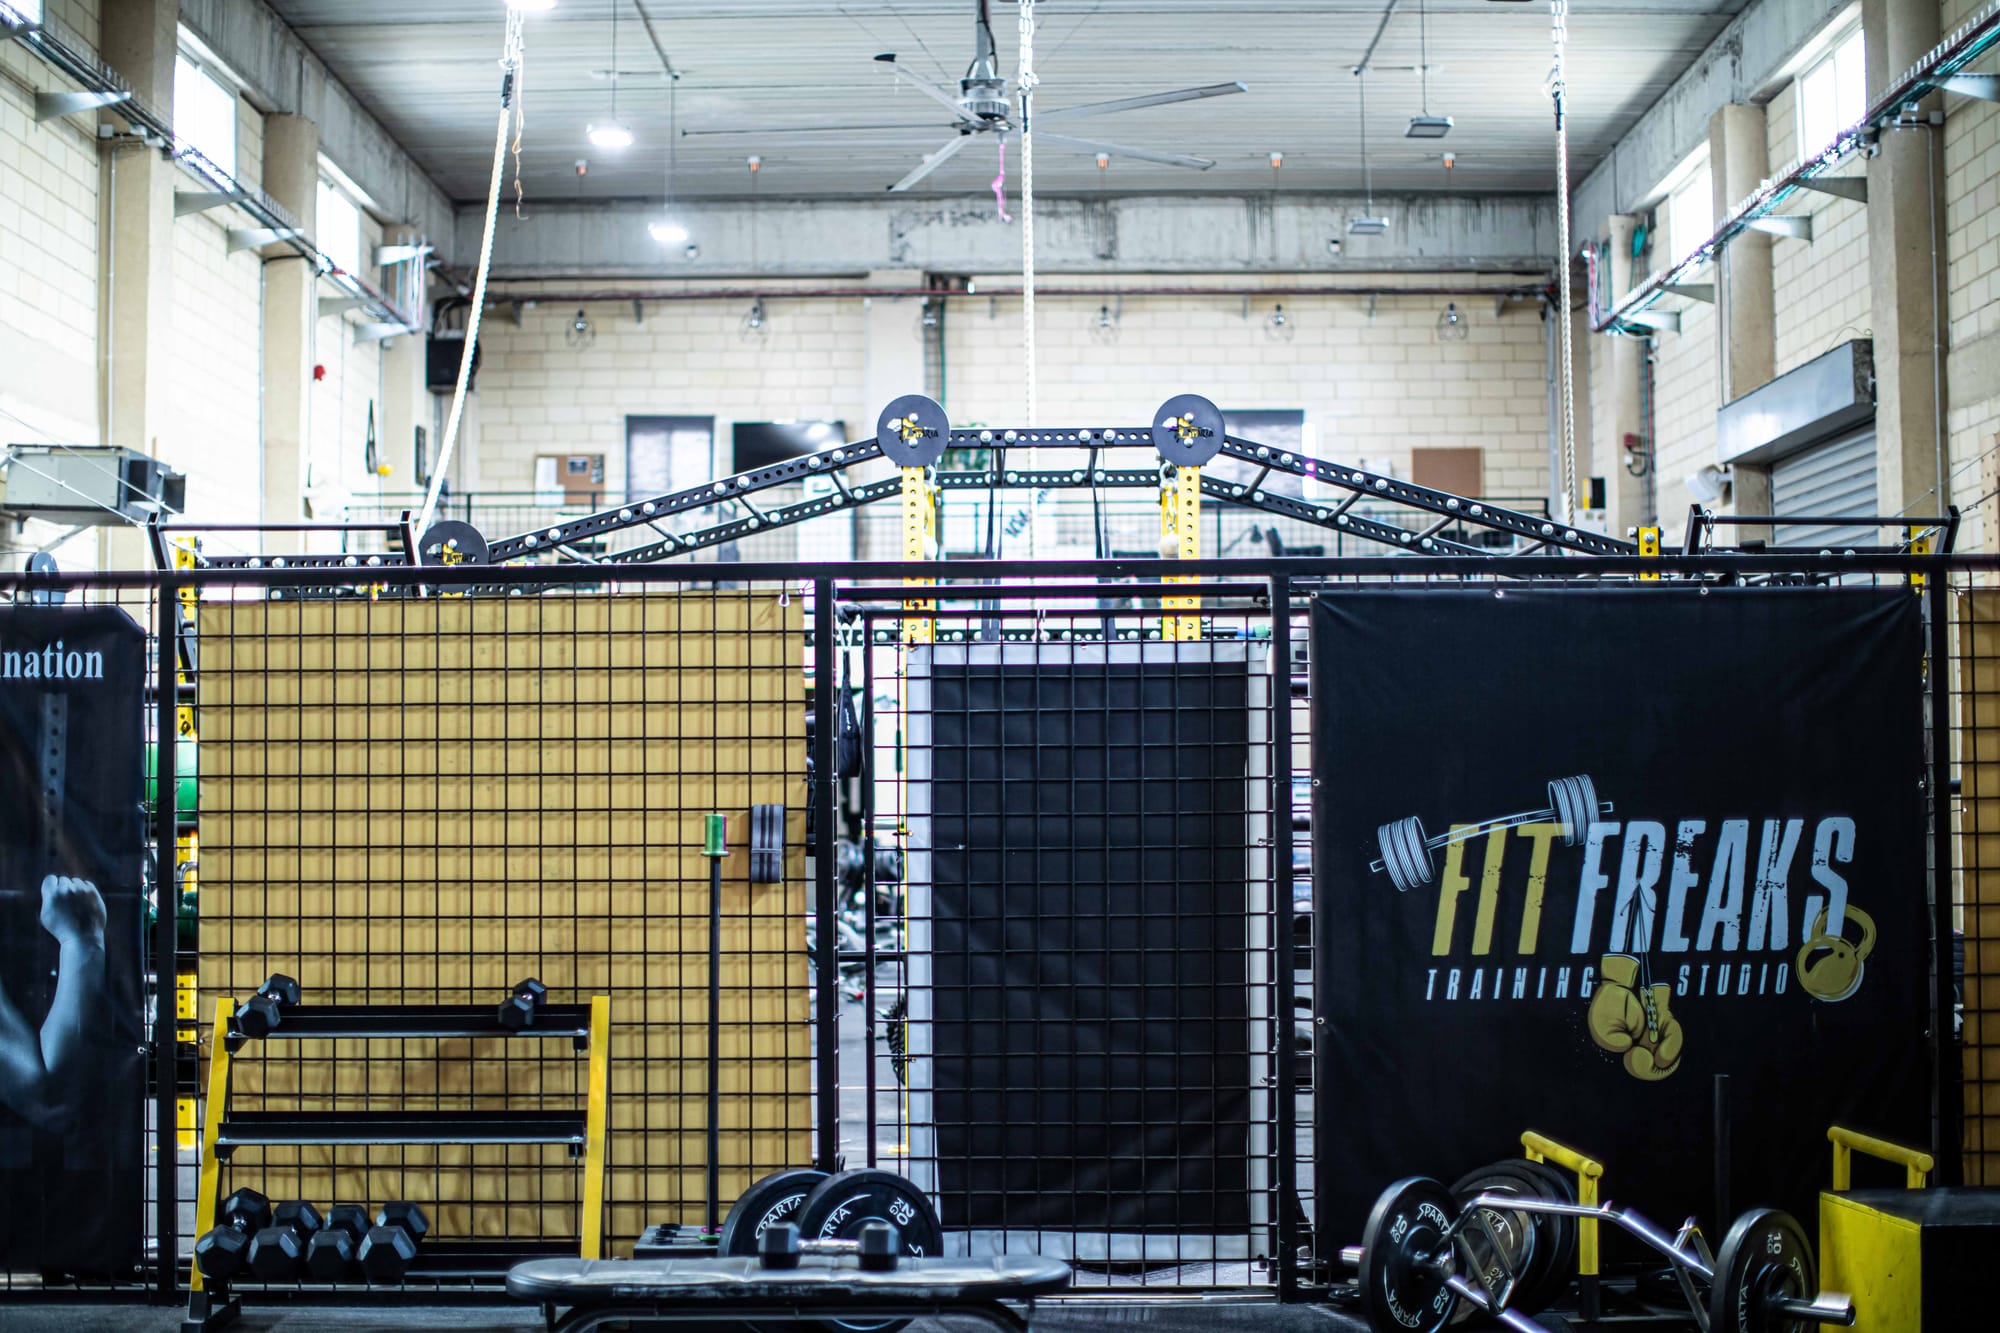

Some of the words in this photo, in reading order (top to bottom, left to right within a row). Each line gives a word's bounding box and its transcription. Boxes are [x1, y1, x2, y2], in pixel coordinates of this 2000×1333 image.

[0, 640, 104, 679] nation
[1432, 823, 1575, 956] FIT
[1570, 816, 1857, 954] FREAKS
[1426, 966, 1595, 1001] TRAINING
[1676, 963, 1789, 997] STUDIO
[889, 1197, 903, 1216] KG
[896, 1202, 915, 1226] 20
[1389, 1226, 1402, 1244] KG
[1394, 1215, 1408, 1235] 10
[1766, 1233, 1775, 1255] KG
[1773, 1231, 1783, 1255] 10
[1490, 1266, 1505, 1281] KG
[1432, 1295, 1445, 1315] 10
[1438, 1286, 1450, 1302] KG
[1389, 1287, 1423, 1328] SPARTA
